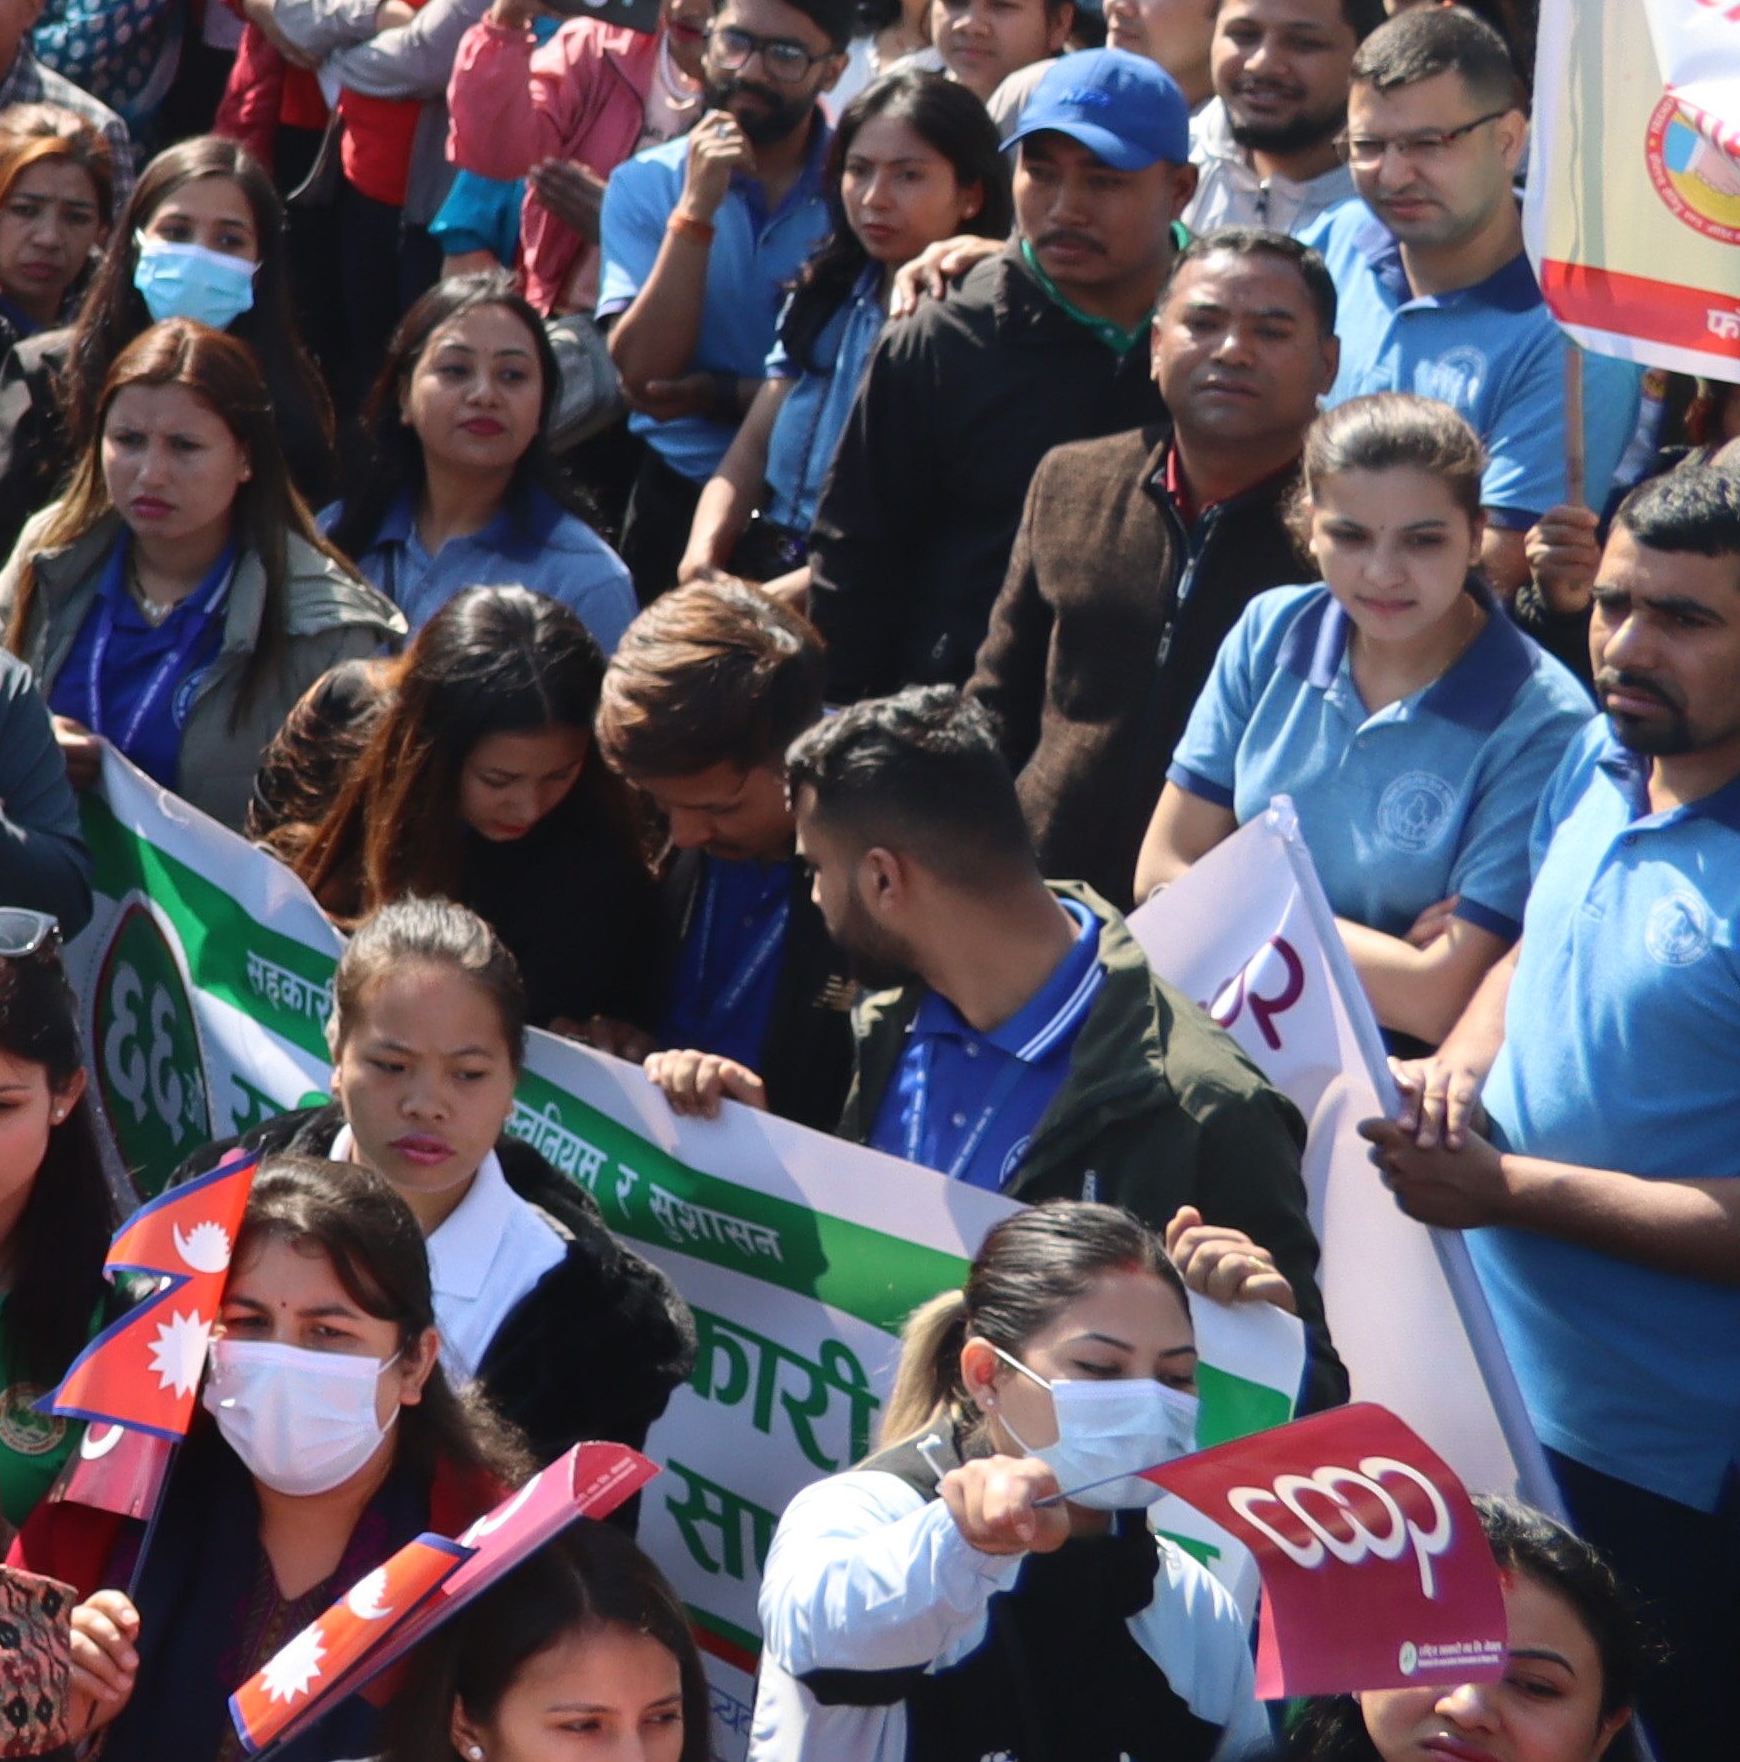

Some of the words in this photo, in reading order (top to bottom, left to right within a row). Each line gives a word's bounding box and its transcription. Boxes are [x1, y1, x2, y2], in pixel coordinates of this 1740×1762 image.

[614, 1162, 640, 1220] र
[648, 1181, 785, 1264] सुशासन
[1227, 1456, 1452, 1600] coop
